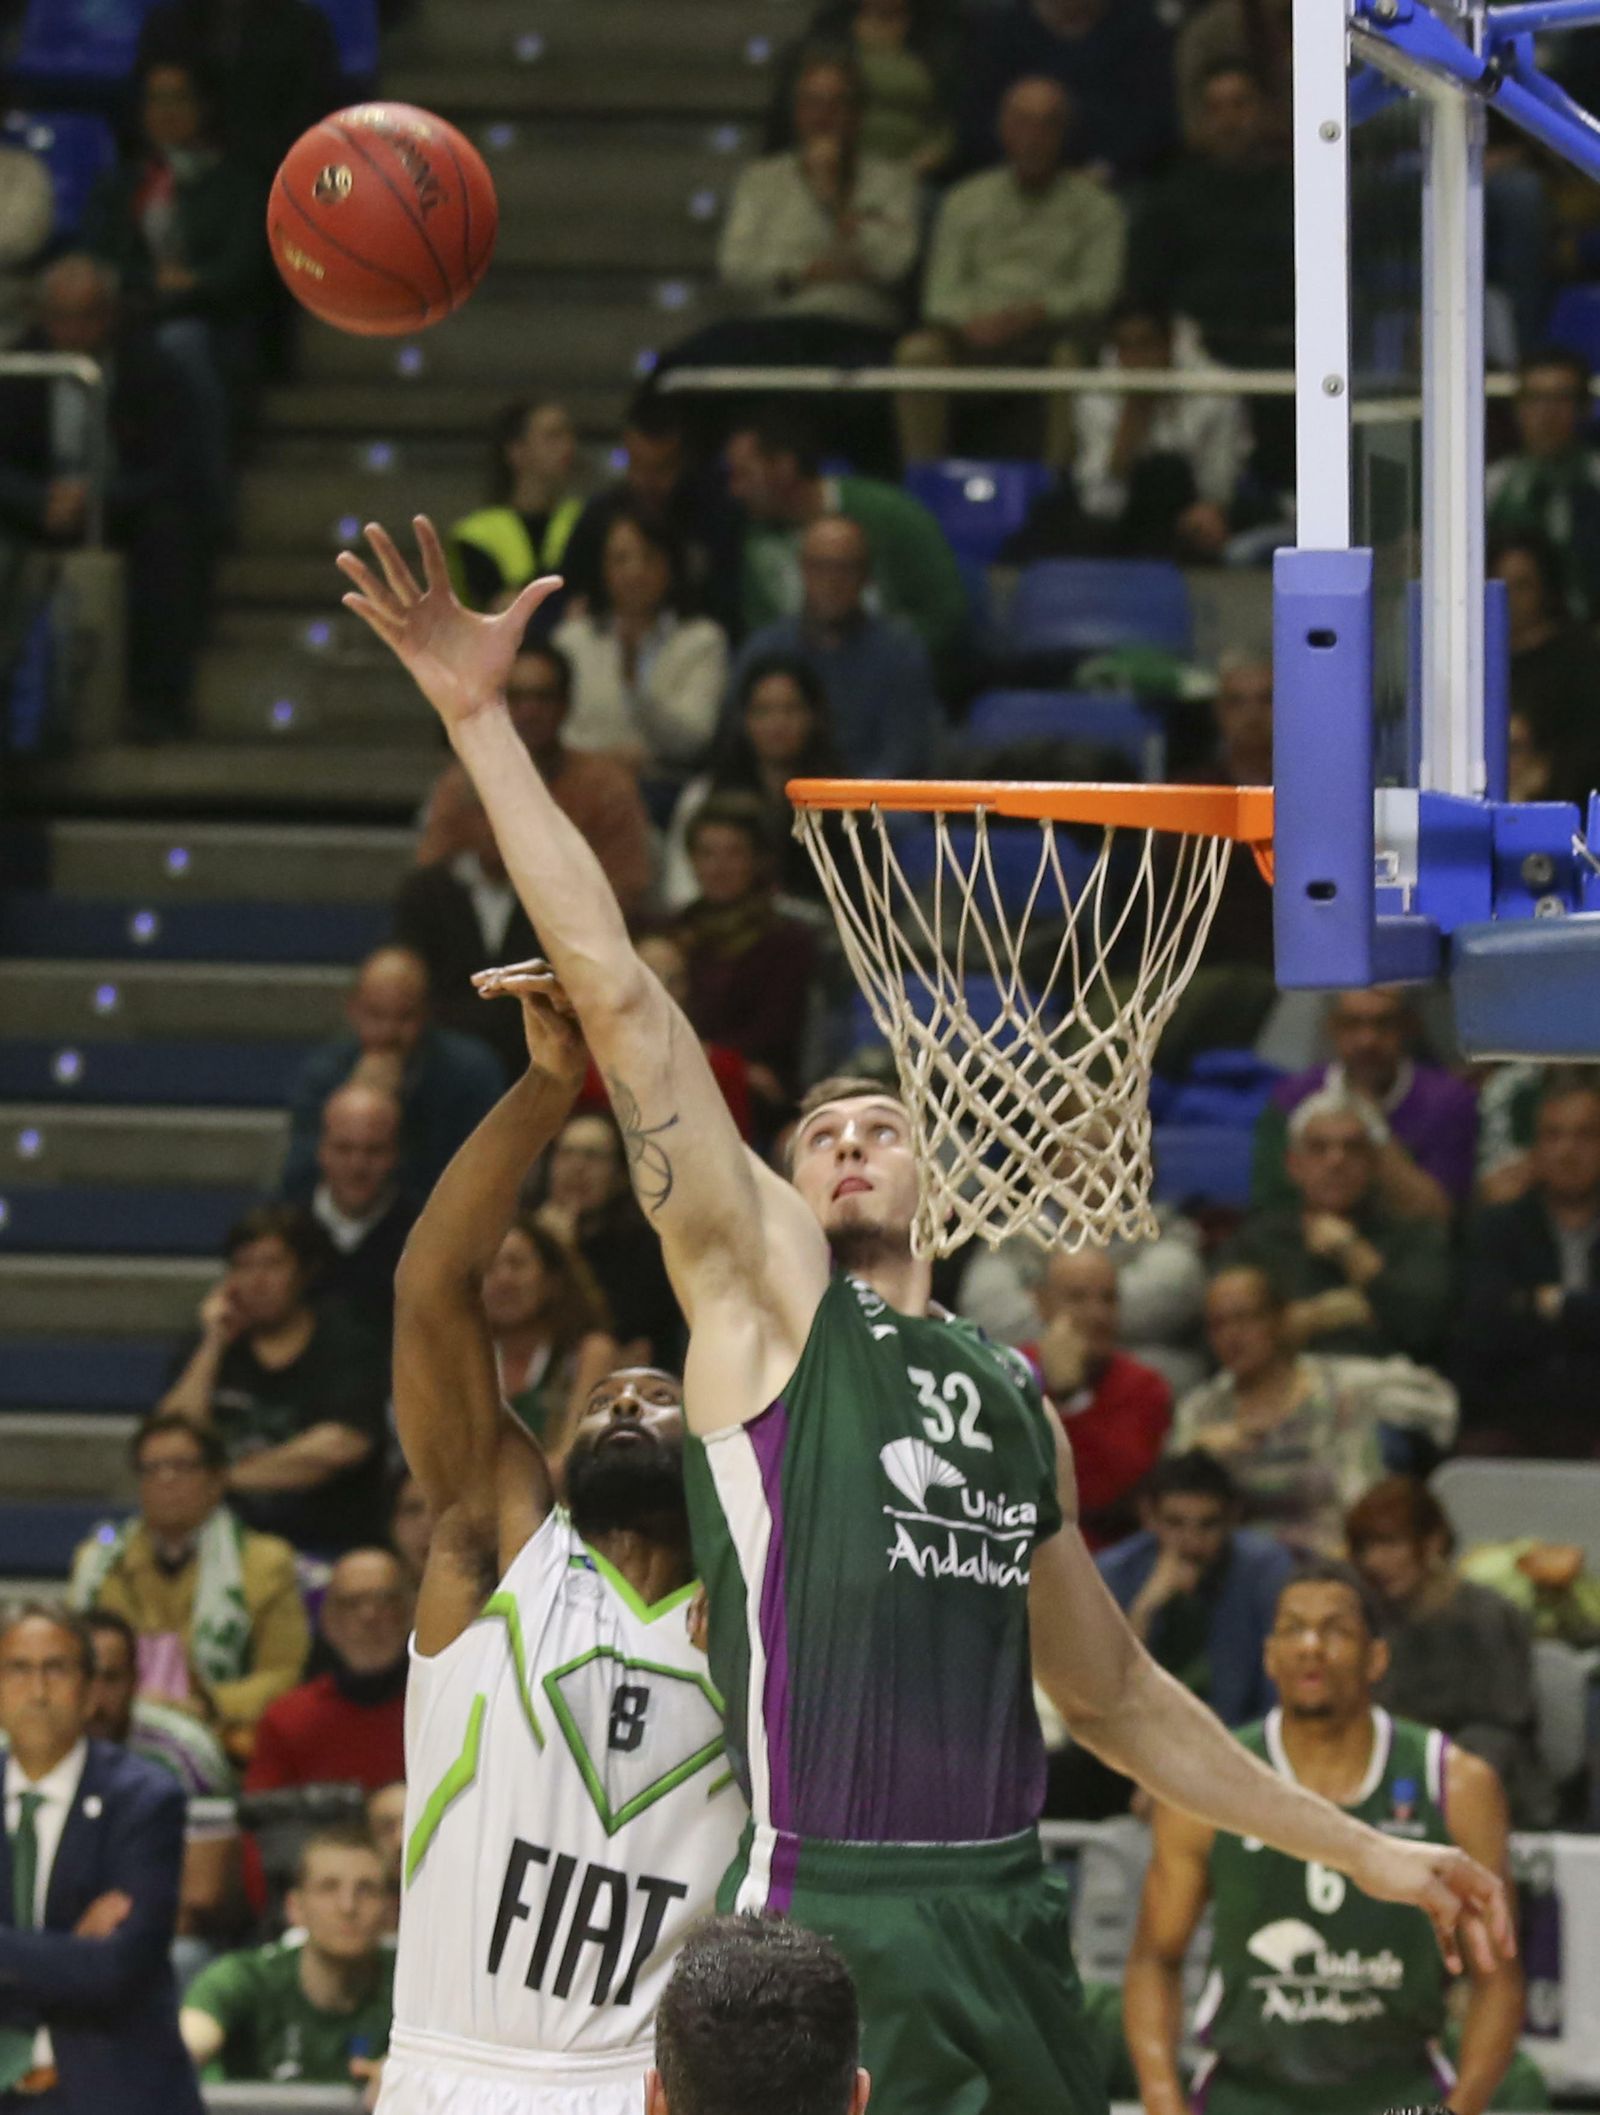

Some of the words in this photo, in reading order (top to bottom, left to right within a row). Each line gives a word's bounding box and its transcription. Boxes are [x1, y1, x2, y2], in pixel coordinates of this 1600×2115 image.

[907, 1365, 994, 1453] 32
[960, 1487, 1038, 1528] Unica
[607, 1683, 650, 1752] 8
[487, 1837, 688, 2006] FIAT
[1306, 1860, 1346, 1914] 6
